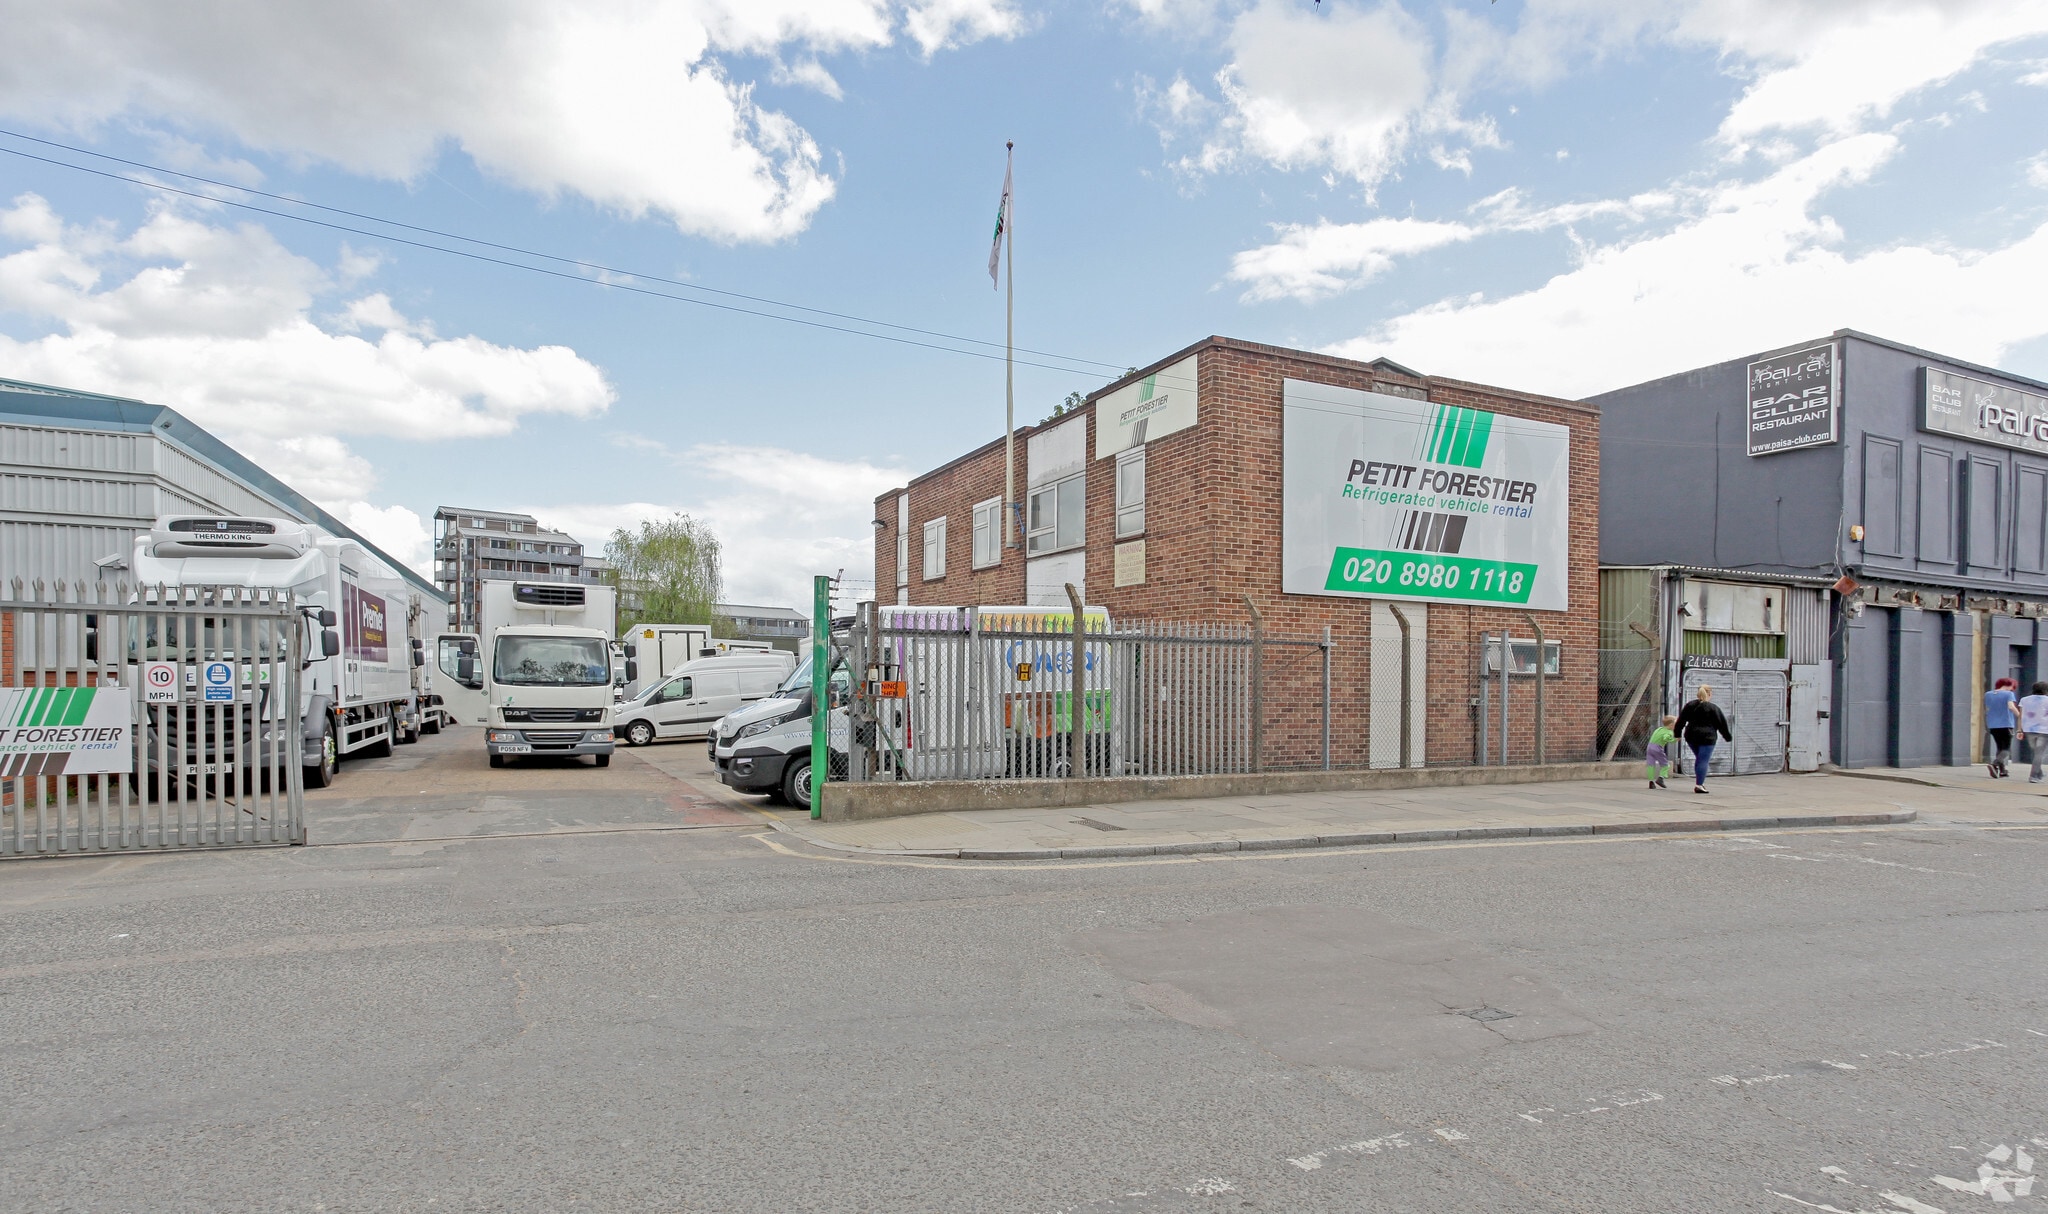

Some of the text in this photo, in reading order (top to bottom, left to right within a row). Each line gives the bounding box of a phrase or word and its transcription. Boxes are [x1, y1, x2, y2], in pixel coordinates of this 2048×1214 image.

[1797, 370, 1830, 381] CLUB
[1752, 386, 1828, 409] BAR
[1932, 384, 1961, 397] BAR
[1120, 395, 1168, 421] PETIT FORESTIER
[1752, 396, 1828, 420] CLUB
[1932, 394, 1962, 407] CLUB
[1931, 404, 1961, 417] RESTAURANT
[1752, 409, 1828, 432] RESTAURANT
[1751, 432, 1830, 452] www.paisa-club.com
[1347, 459, 1537, 504] PETIT FORESTIER
[1342, 484, 1533, 518] Refrigerated vehicle rental
[1343, 557, 1524, 594] 020 8980 1118
[1688, 655, 1700, 667] 24
[1701, 657, 1723, 668] HOURS
[153, 671, 170, 682] 10
[149, 692, 174, 700] MPH
[13, 727, 123, 743] FORESTIER
[33, 742, 77, 751] vehicle
[81, 742, 118, 750] rental
